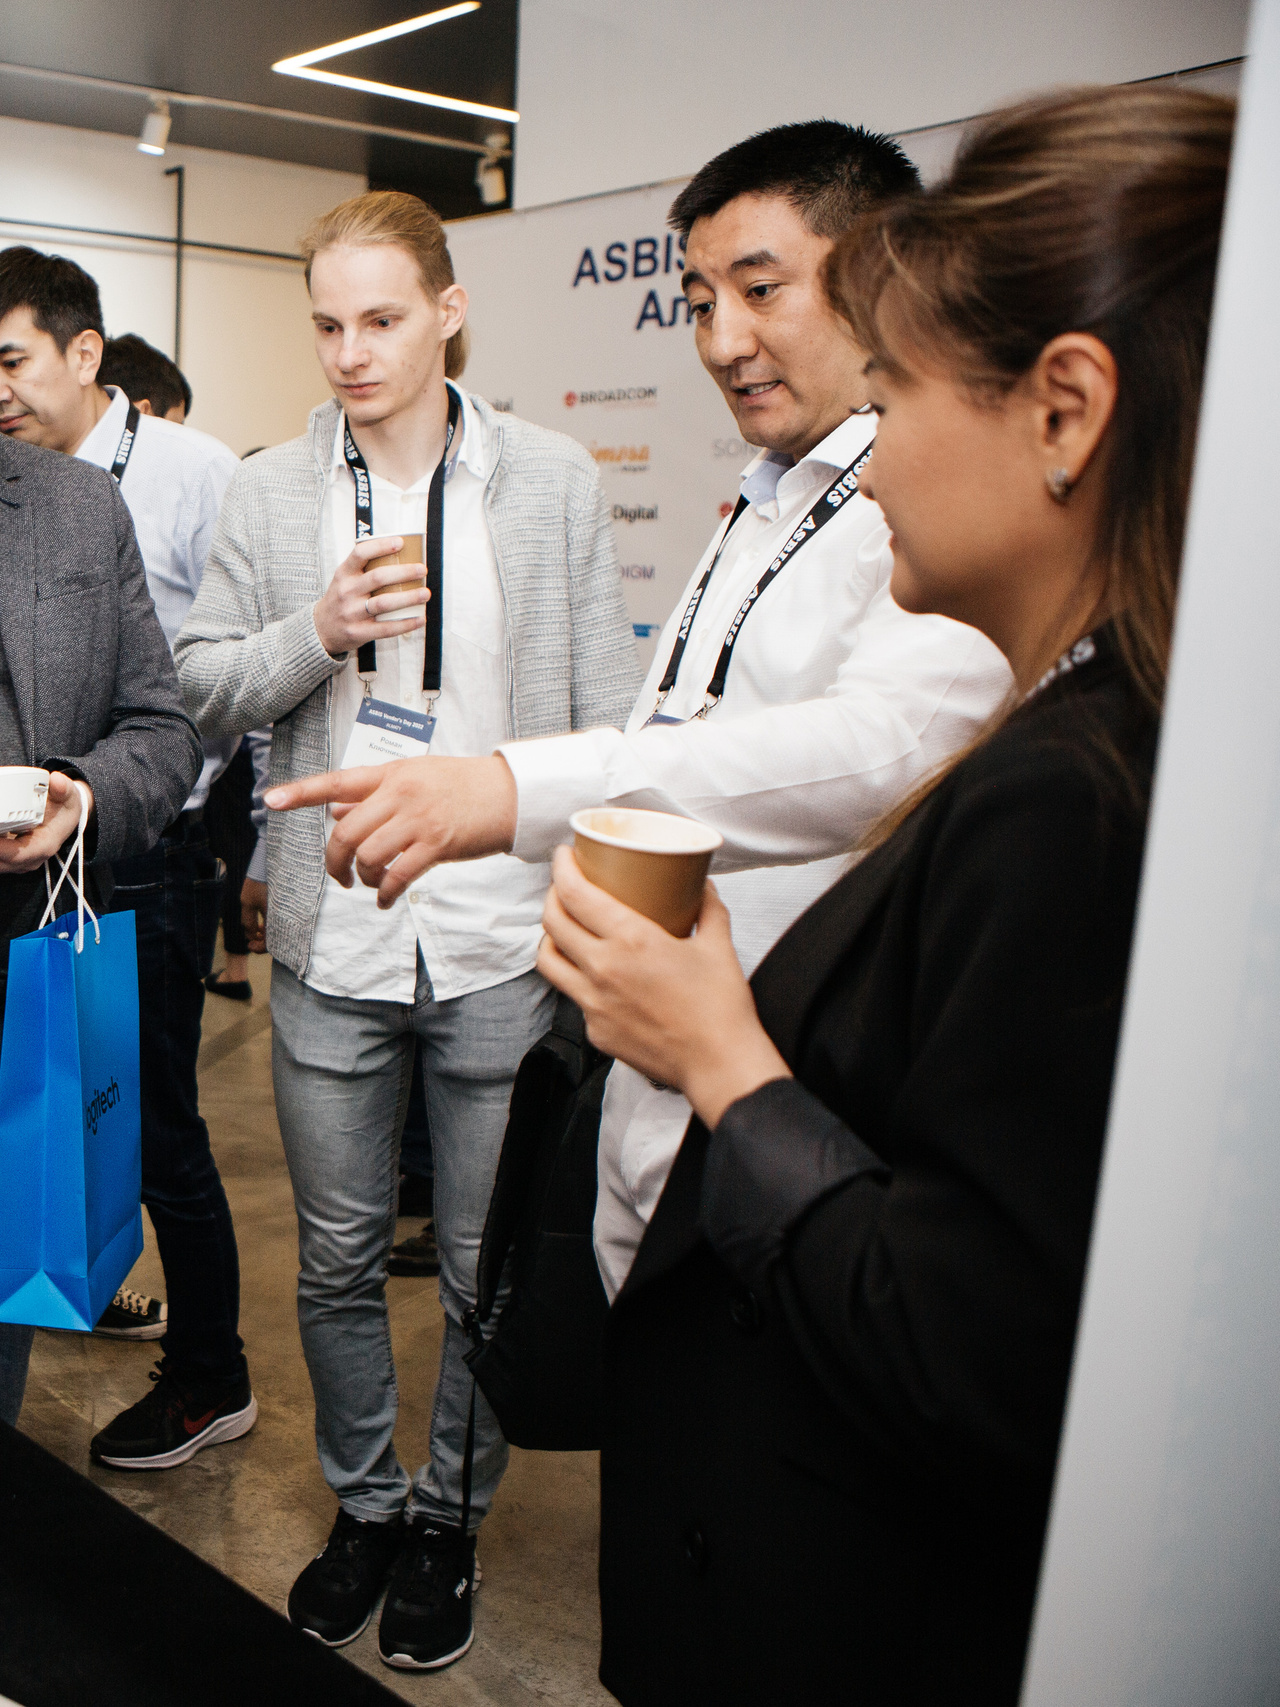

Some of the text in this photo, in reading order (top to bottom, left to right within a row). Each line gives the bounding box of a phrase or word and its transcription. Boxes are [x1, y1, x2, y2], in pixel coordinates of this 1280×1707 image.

[579, 386, 658, 404] BROADCOM
[353, 466, 370, 508] ASBIS
[613, 504, 659, 523] Digital
[770, 515, 817, 572] ASBIS
[678, 587, 703, 640] ASBIS
[725, 585, 758, 647] ASBIS
[85, 1075, 120, 1136] ogitech
